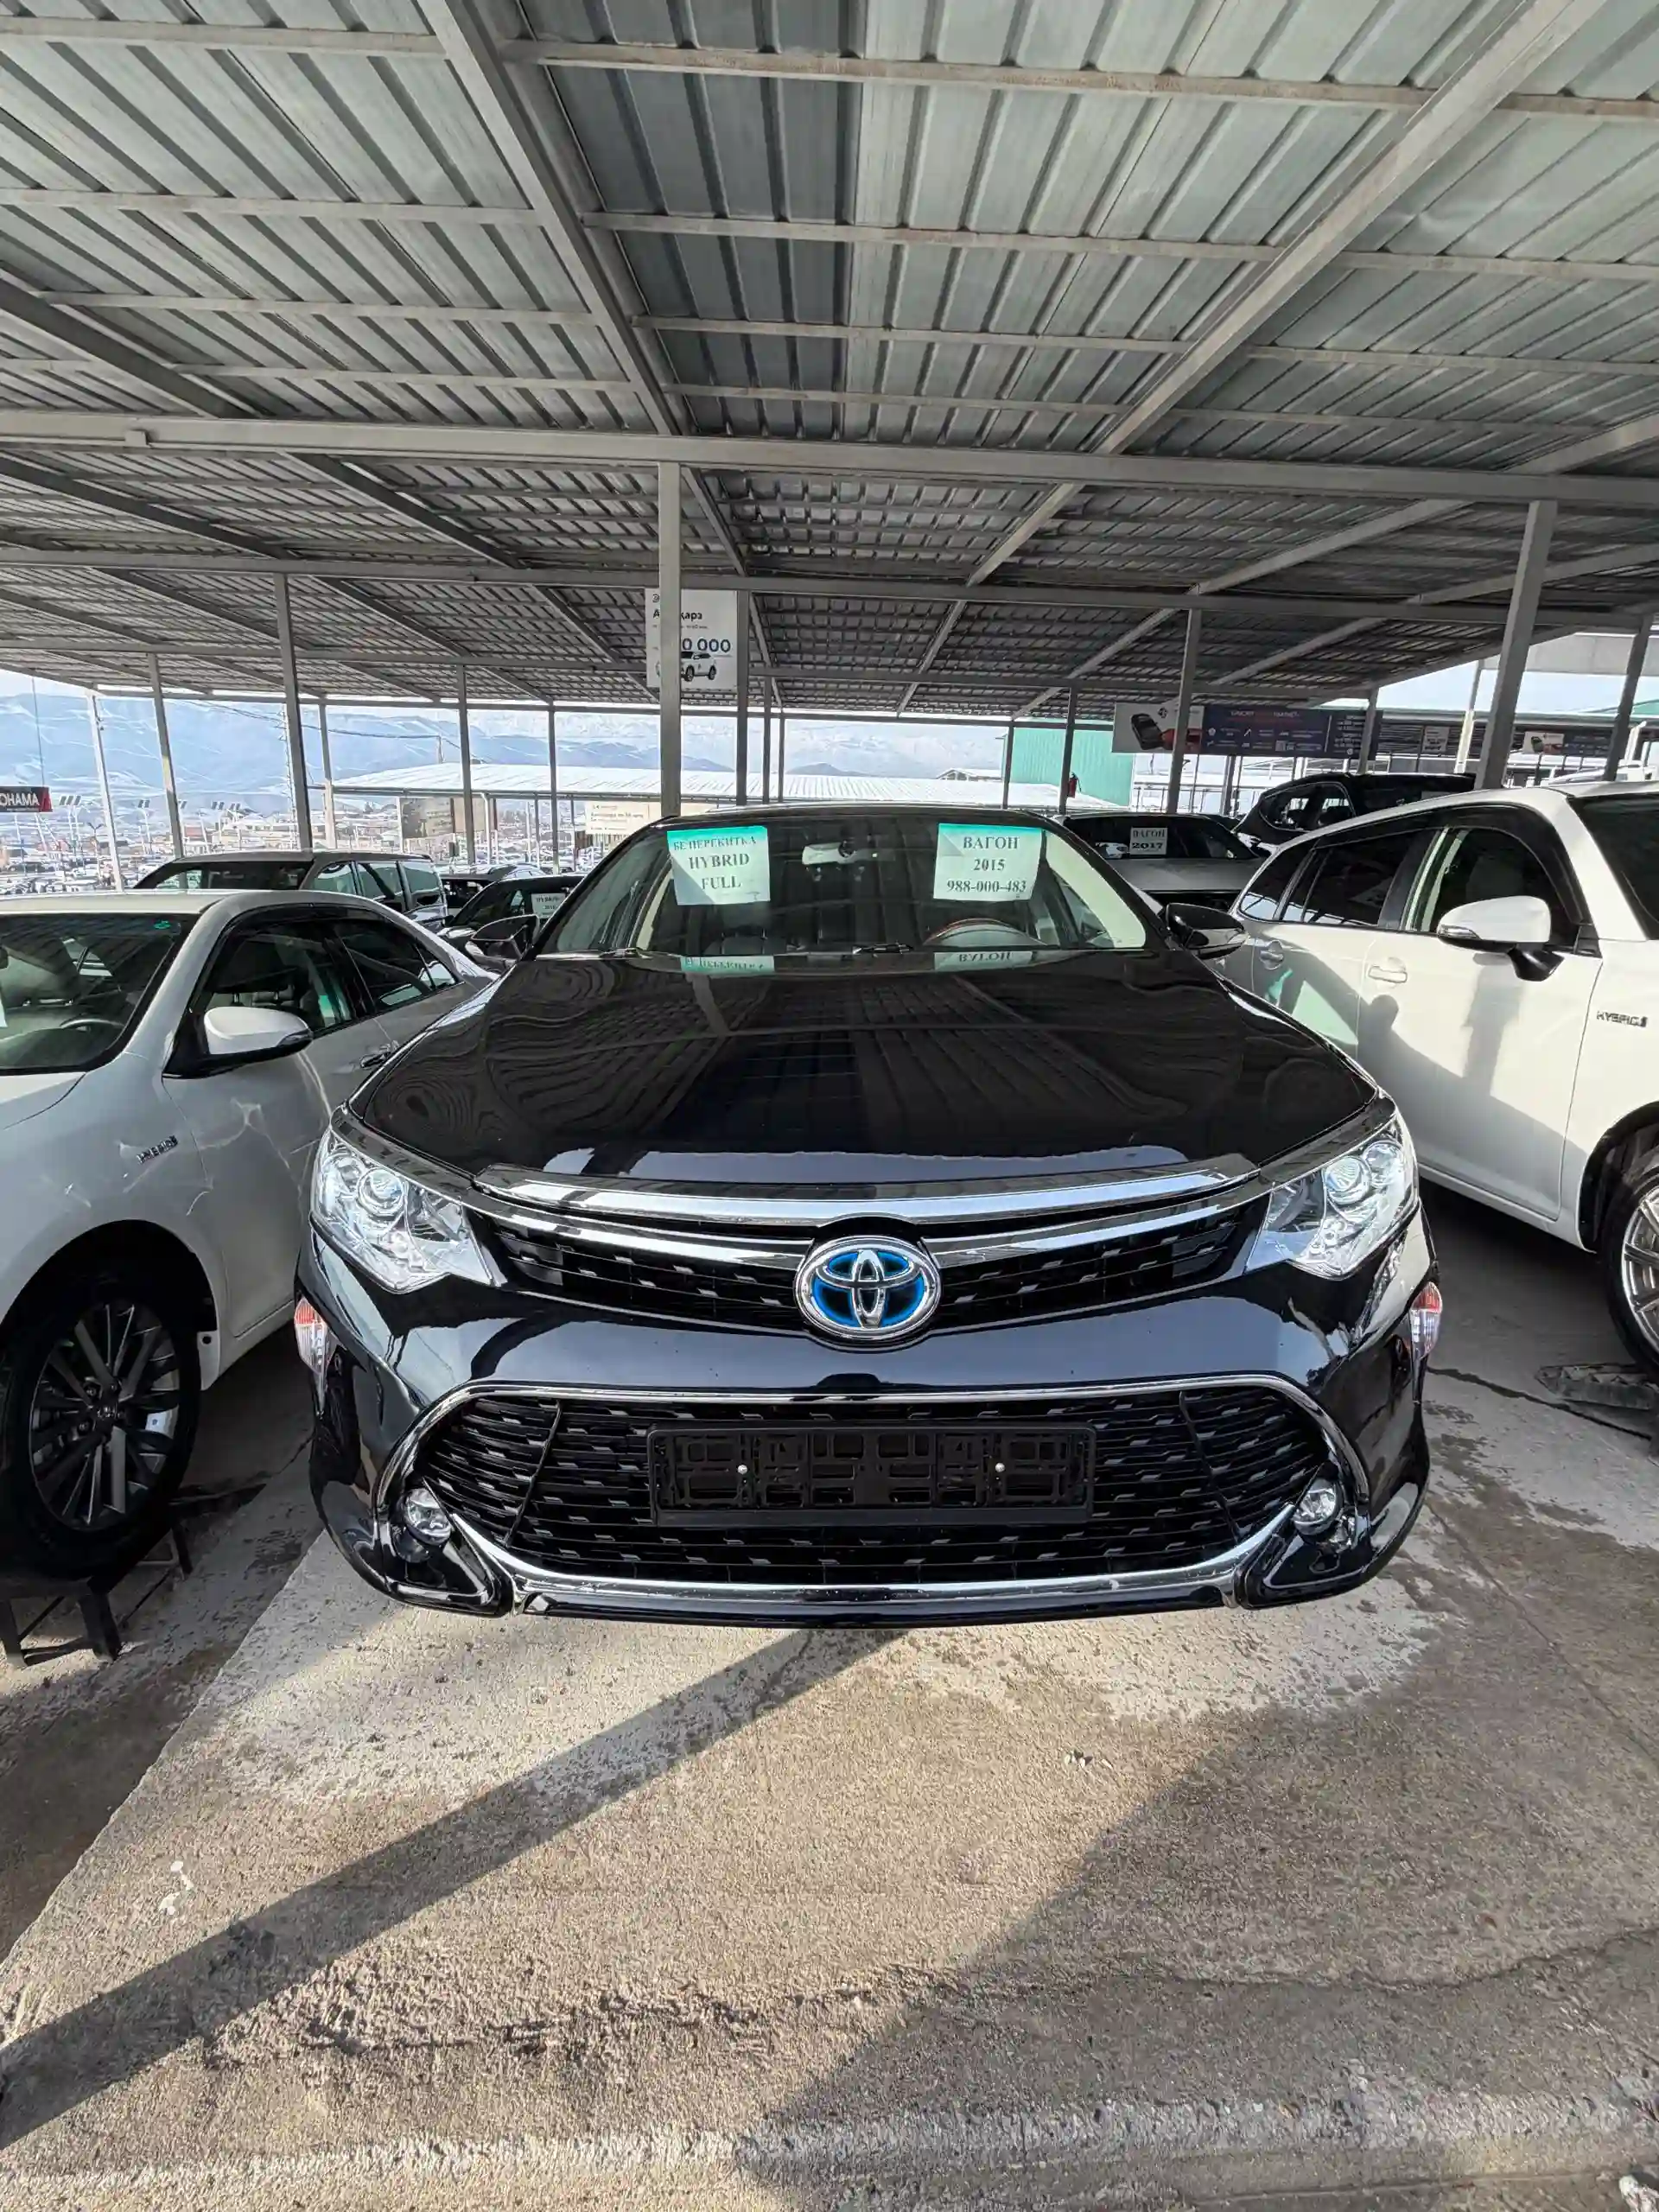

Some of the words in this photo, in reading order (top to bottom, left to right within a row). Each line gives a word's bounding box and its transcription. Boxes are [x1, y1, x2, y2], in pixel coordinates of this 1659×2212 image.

[963, 836, 1020, 849] ВАГОН
[689, 853, 750, 869] HYBRID
[973, 859, 1006, 871] 2015
[701, 875, 741, 890] FULL
[946, 880, 1027, 893] 988-000-483
